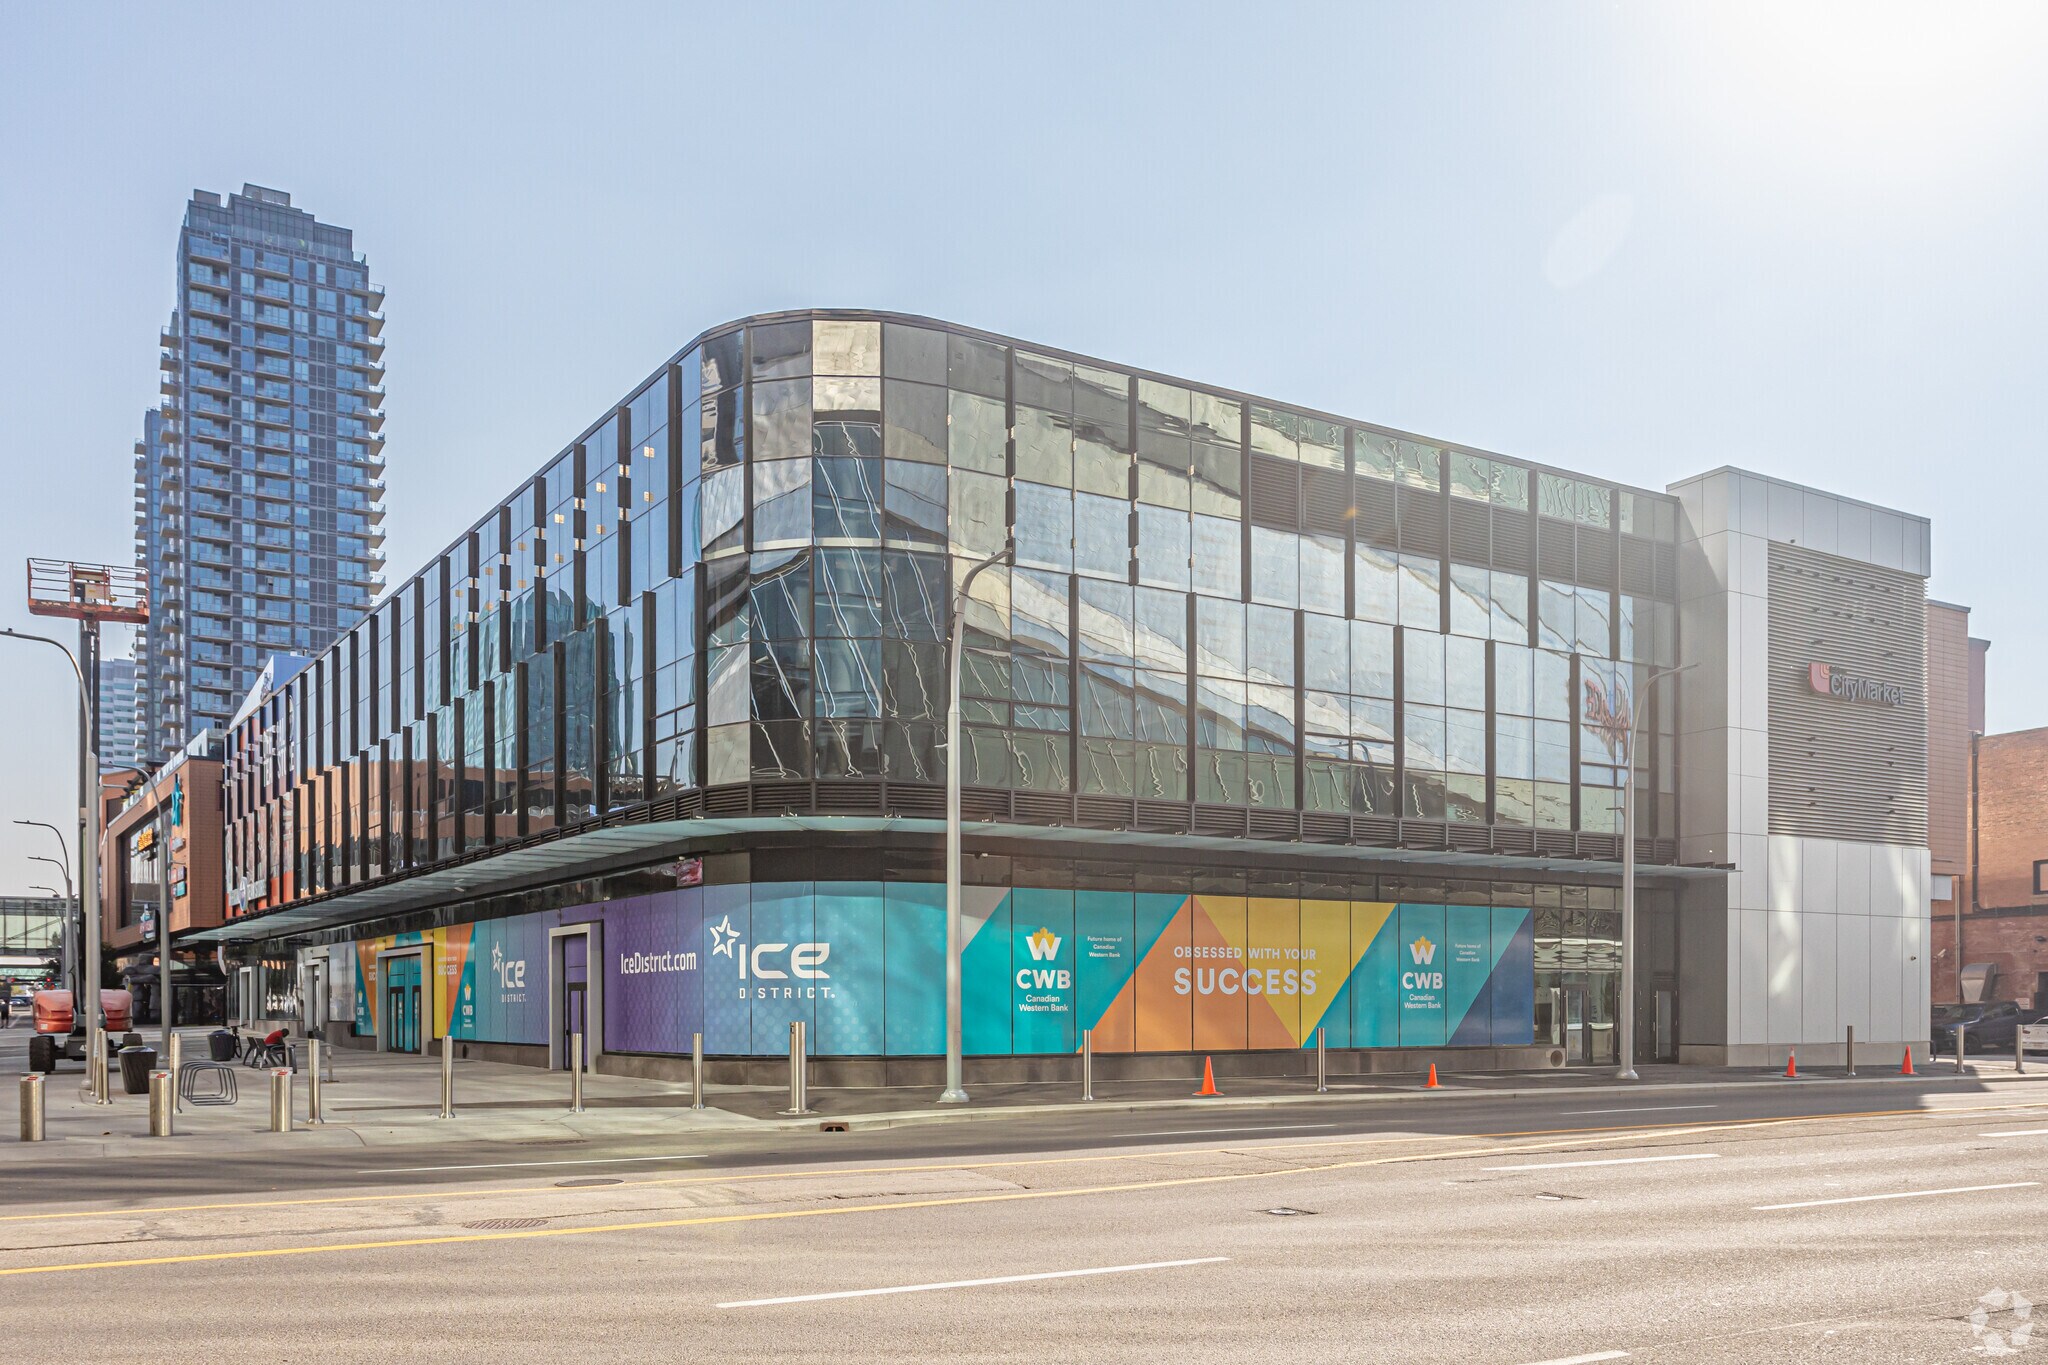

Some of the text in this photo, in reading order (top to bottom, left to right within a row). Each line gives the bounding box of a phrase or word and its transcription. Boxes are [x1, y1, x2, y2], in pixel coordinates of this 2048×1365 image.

[1831, 673, 1904, 705] CityMarket
[1173, 946, 1316, 960] OBSESSED WITH YOUR
[620, 950, 697, 975] IceDistrict.com
[1016, 968, 1071, 990] CWB
[1402, 971, 1443, 990] CWB
[1025, 994, 1060, 1003] Canadian
[1409, 993, 1436, 1001] Canadian
[1019, 1003, 1069, 1012] Western Bank
[1428, 1001, 1441, 1009] Bank
